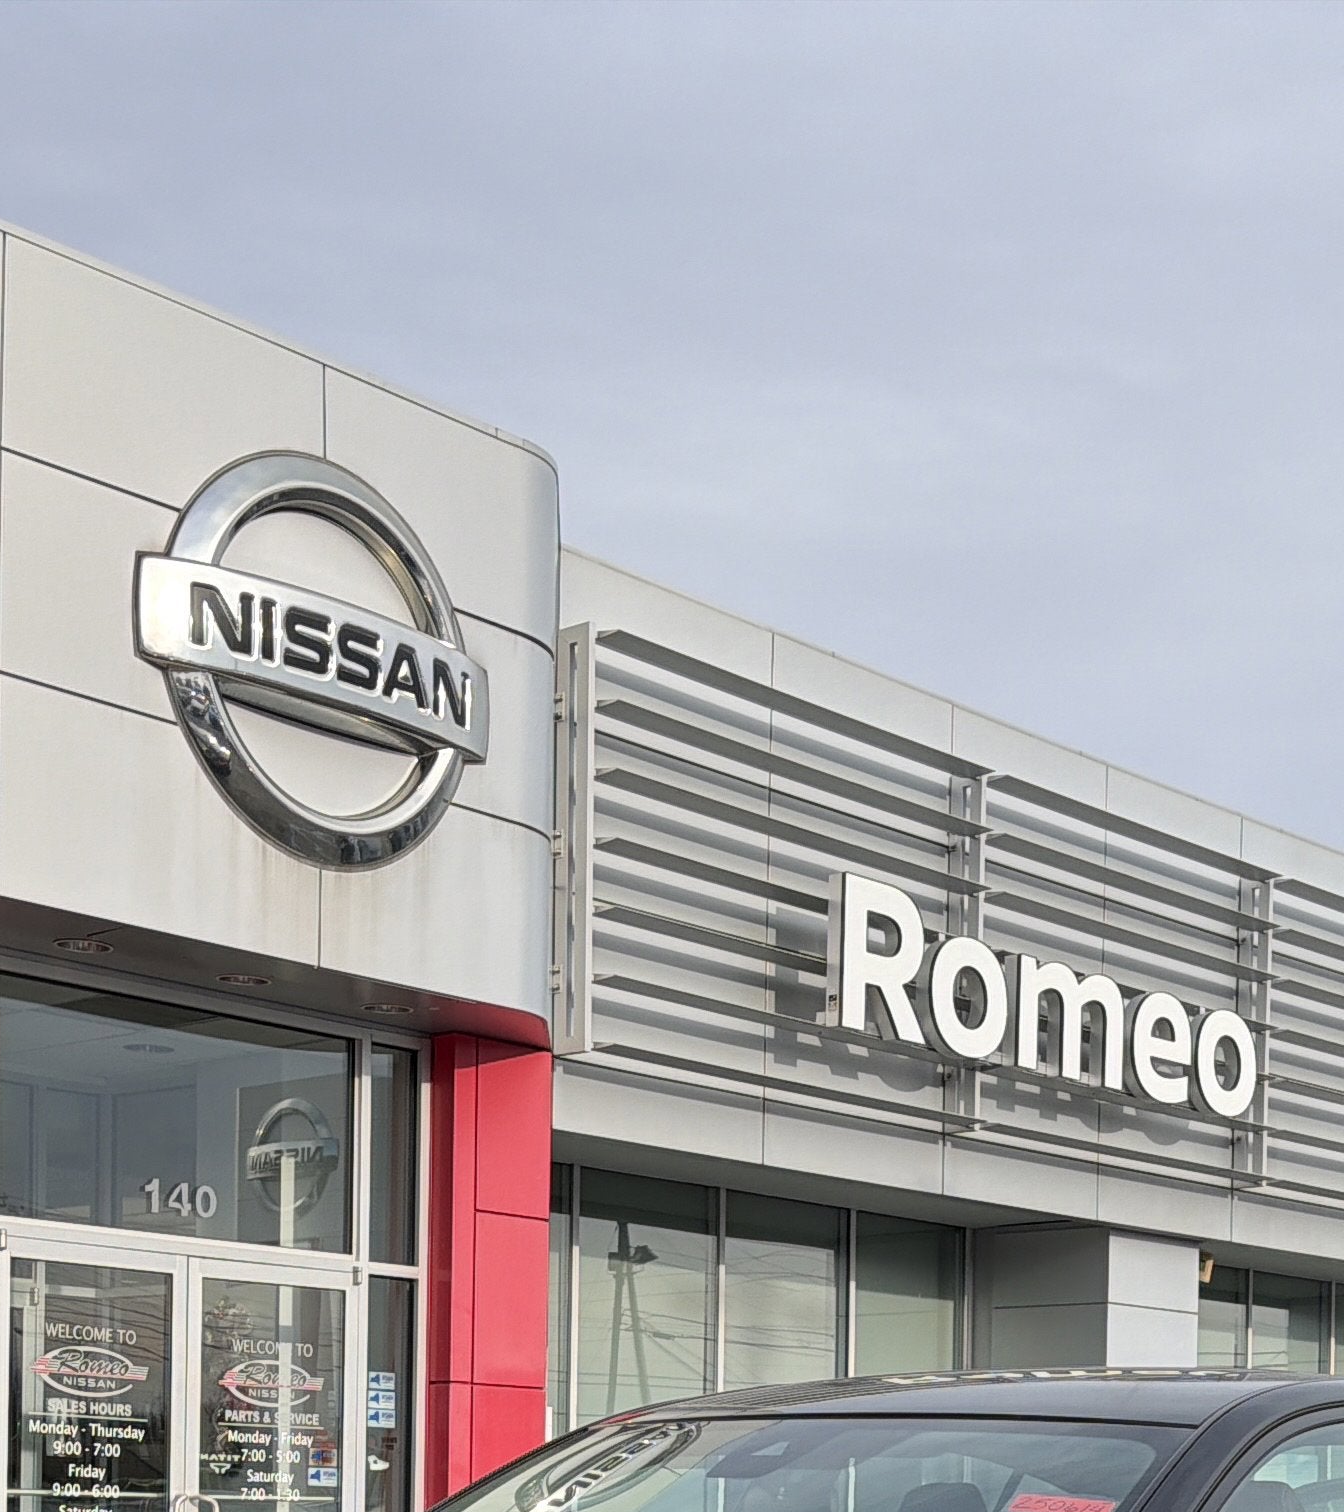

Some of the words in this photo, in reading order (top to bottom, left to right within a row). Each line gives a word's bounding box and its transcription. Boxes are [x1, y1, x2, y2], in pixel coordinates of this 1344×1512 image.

[189, 580, 473, 732] NISSAN
[836, 871, 1257, 1118] Romeo
[144, 1177, 218, 1218] 140
[45, 1322, 114, 1343] WELCOME
[117, 1329, 137, 1345] TO
[233, 1338, 292, 1357] WELCO
[296, 1343, 313, 1358] TO
[54, 1348, 131, 1376] Romeo
[63, 1376, 116, 1390] NISSAN
[248, 1388, 295, 1399] NISSN
[47, 1399, 87, 1414] SALES
[89, 1401, 133, 1417] HOURS
[225, 1409, 260, 1423] PARTS
[262, 1411, 271, 1424] &
[275, 1412, 320, 1426] SRVICE
[28, 1419, 79, 1438] Monday
[89, 1422, 146, 1442] Thursday
[227, 1429, 272, 1447] Monday
[281, 1431, 314, 1449] Friday
[53, 1440, 82, 1456] 9:00
[93, 1442, 121, 1458] 7:00
[241, 1449, 266, 1462] 7:00
[276, 1450, 301, 1464] 5:00
[68, 1463, 107, 1481] Friday
[247, 1469, 295, 1486] Saturday
[52, 1482, 81, 1497] 9:00
[92, 1484, 120, 1499] 6:00
[240, 1487, 266, 1501] 7:00
